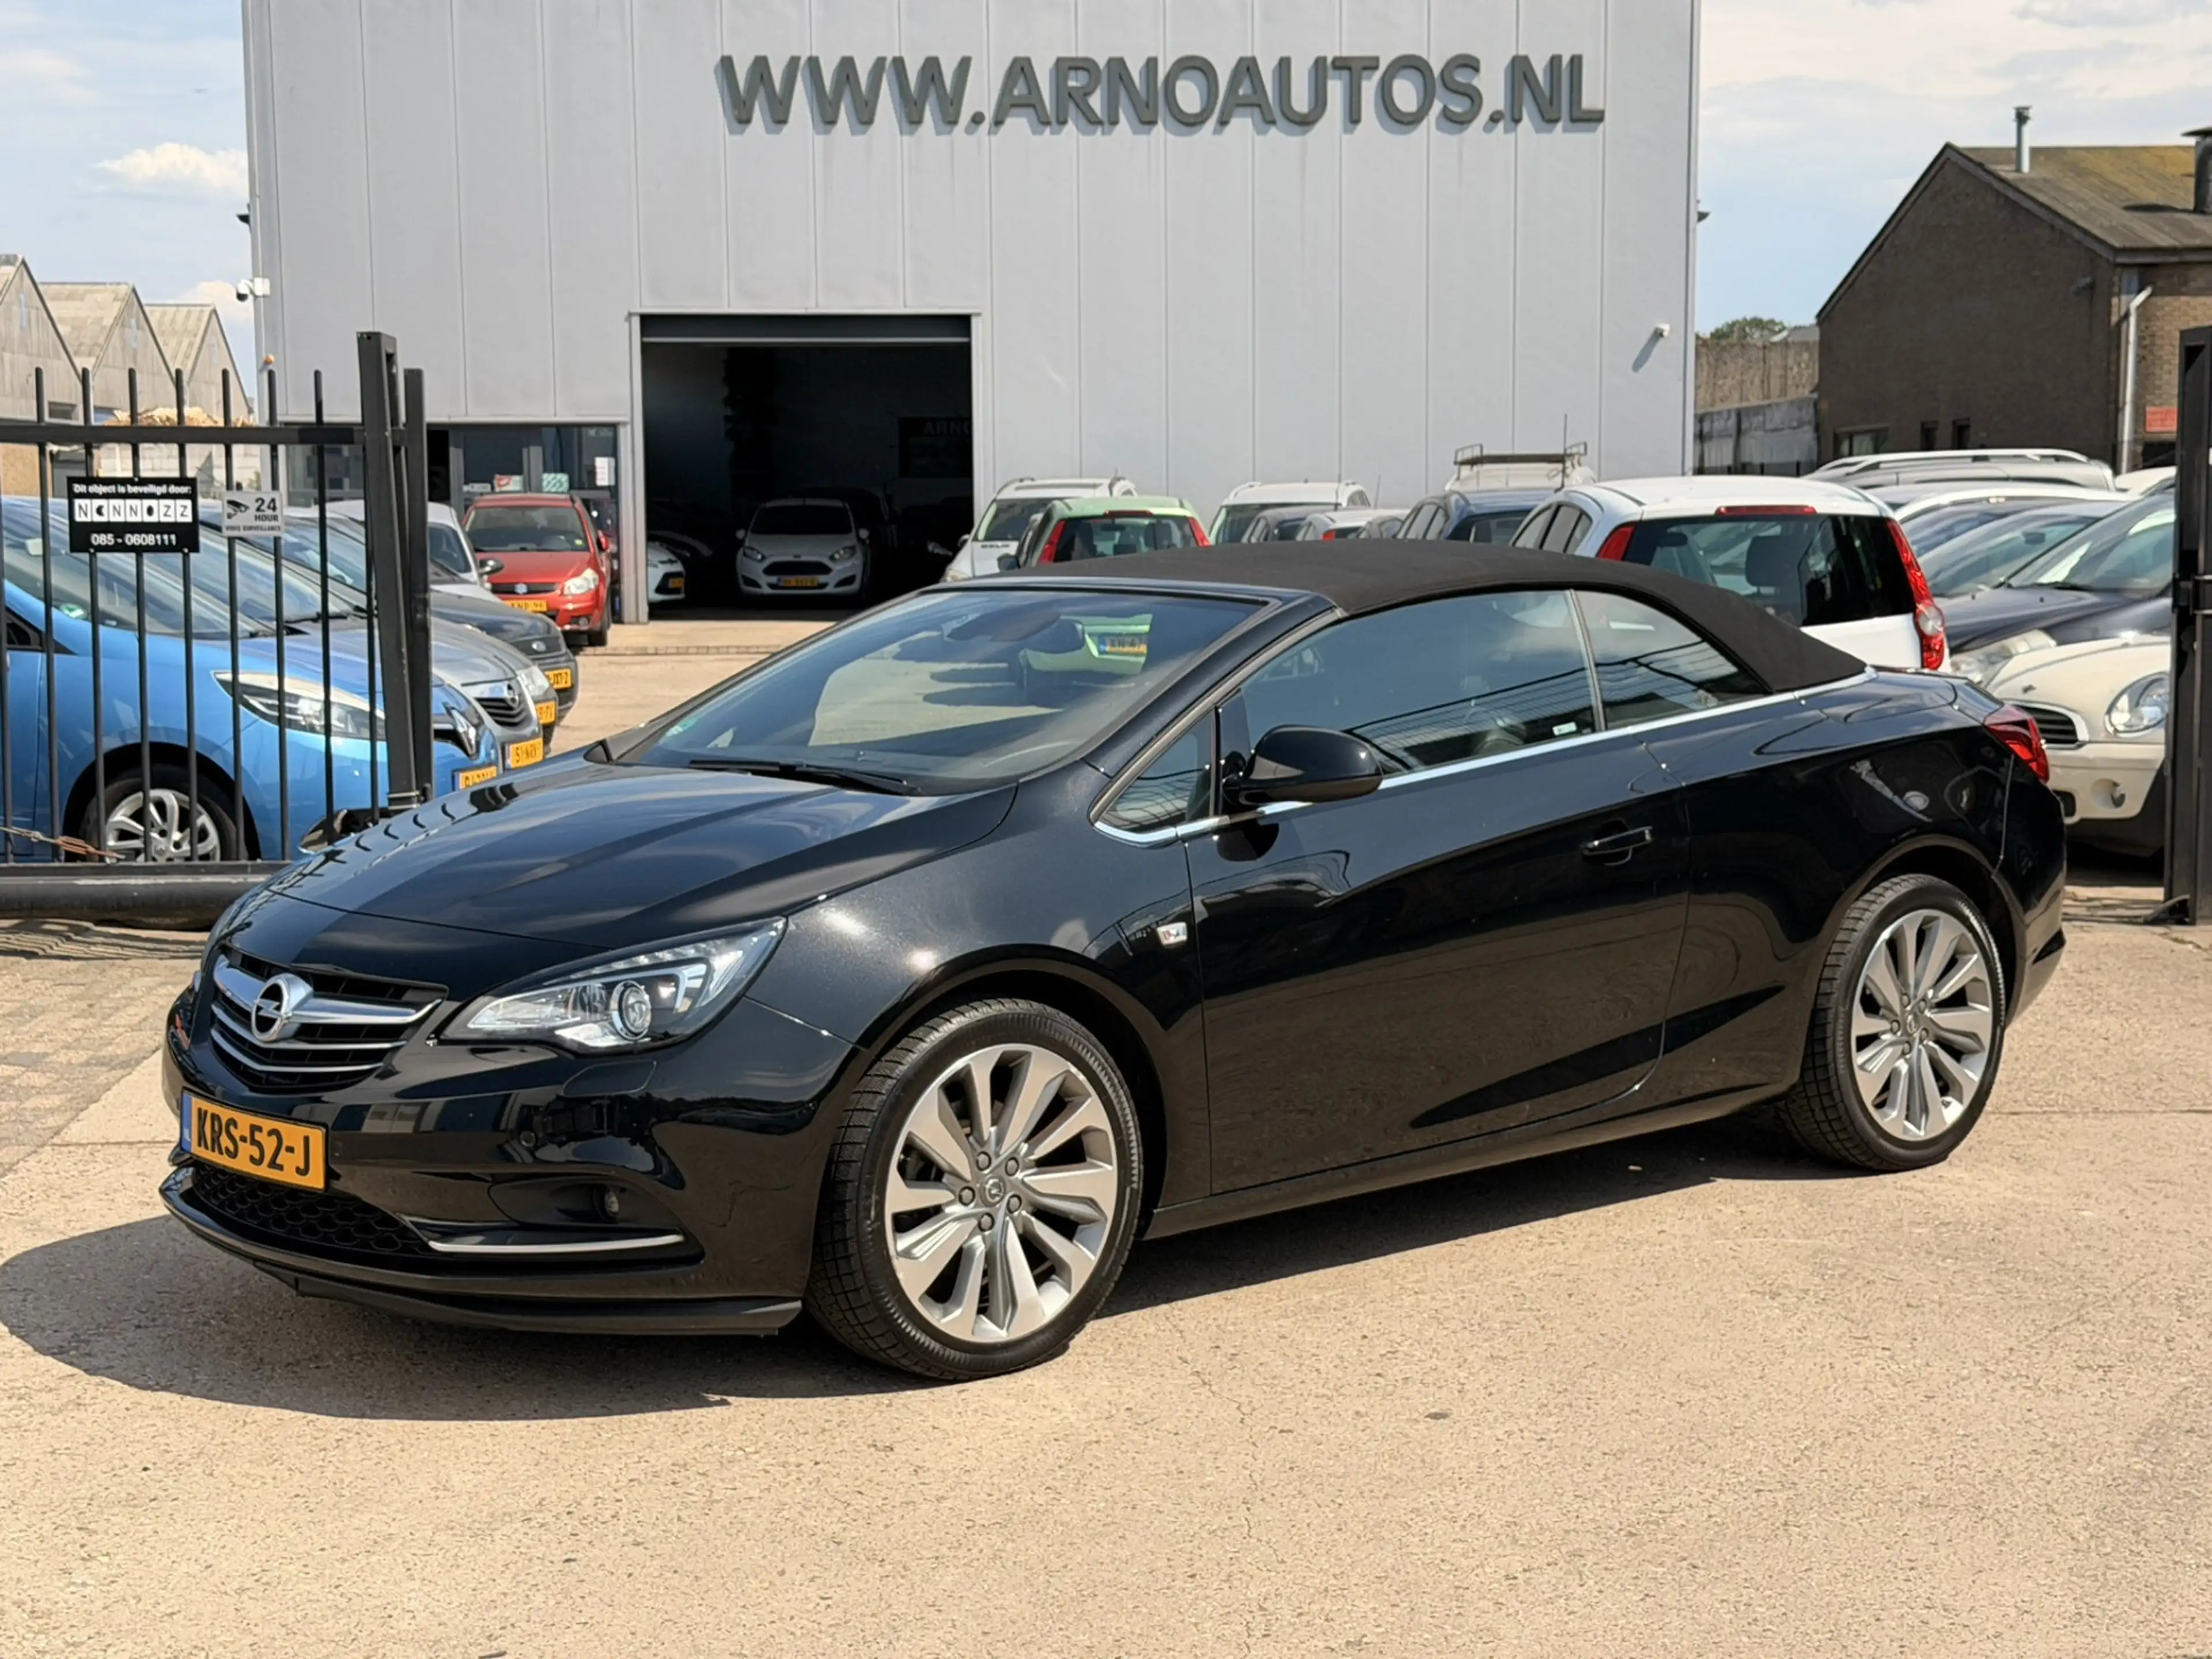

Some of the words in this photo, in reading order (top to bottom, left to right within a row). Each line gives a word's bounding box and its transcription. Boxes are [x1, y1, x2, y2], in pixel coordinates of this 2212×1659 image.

[720, 53, 1605, 124] WWW.ARNOAUTOS.NL
[88, 484, 116, 495] object
[118, 484, 126, 494] is
[255, 497, 277, 512] 24
[255, 514, 279, 522] HOUR
[90, 533, 115, 546] 085
[197, 1107, 310, 1177] KRS-52-J
